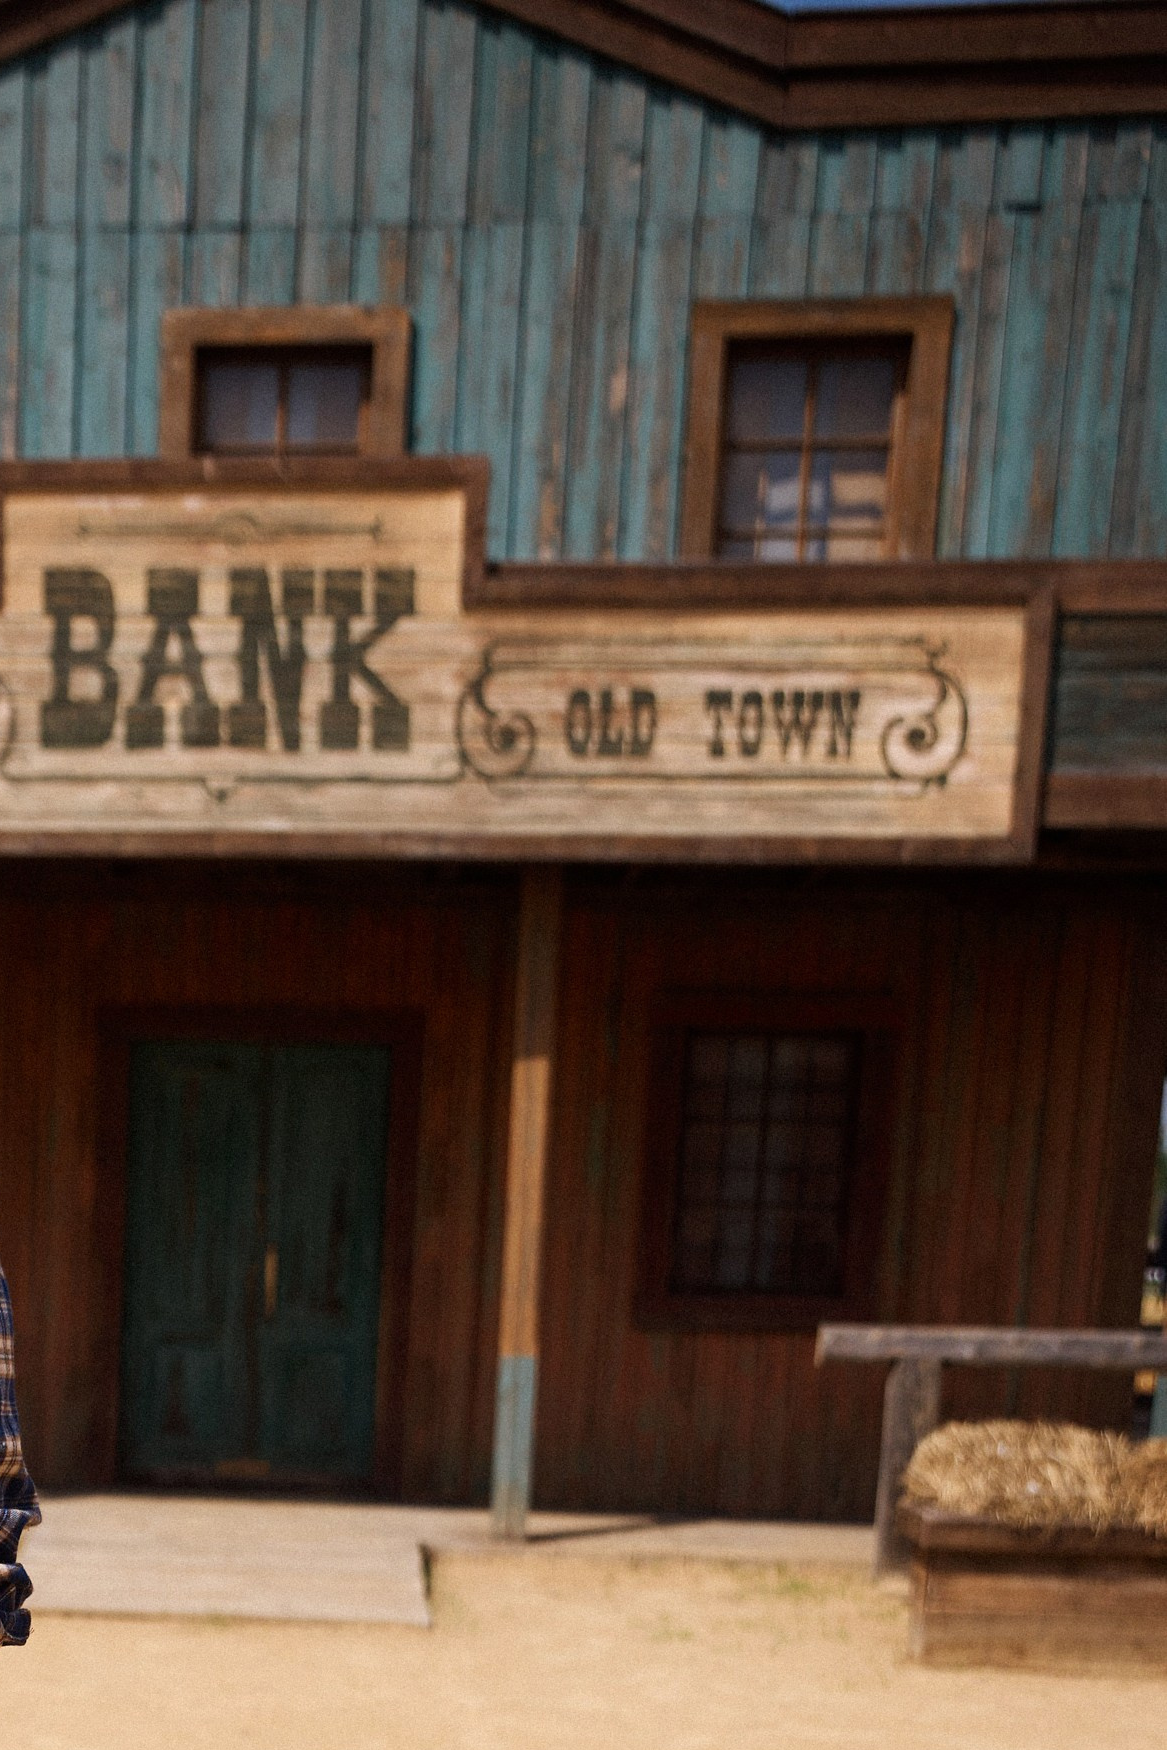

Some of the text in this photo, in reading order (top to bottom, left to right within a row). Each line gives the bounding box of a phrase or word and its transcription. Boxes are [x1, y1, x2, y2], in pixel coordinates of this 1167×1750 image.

[41, 566, 417, 752] BANK
[565, 688, 862, 758] OLD TOWN
